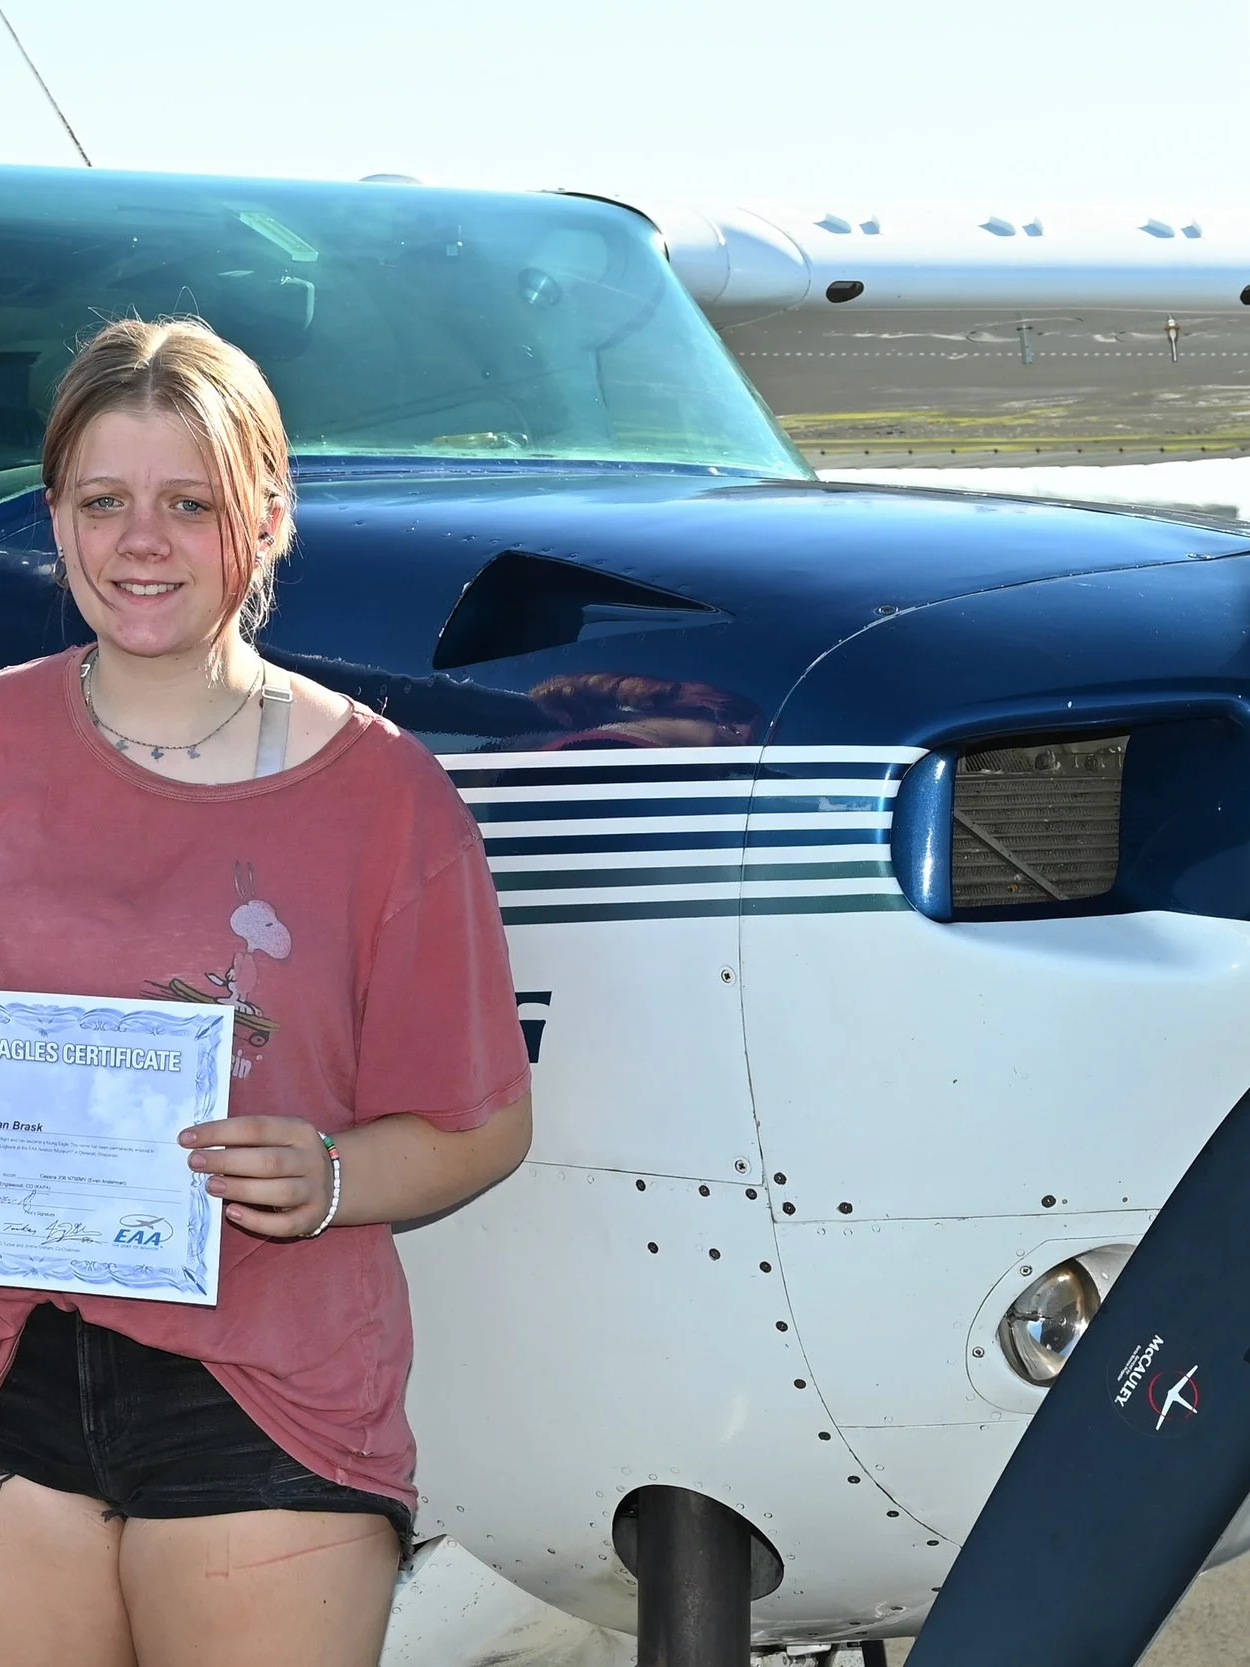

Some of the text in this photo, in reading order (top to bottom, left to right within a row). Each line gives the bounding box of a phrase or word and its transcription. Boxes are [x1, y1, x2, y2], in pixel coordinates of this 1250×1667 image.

[62, 1043, 181, 1072] CERTIFICATE
[12, 1121, 43, 1132] Brask
[114, 1229, 161, 1246] EAA
[1114, 1334, 1165, 1407] McCAULEY
